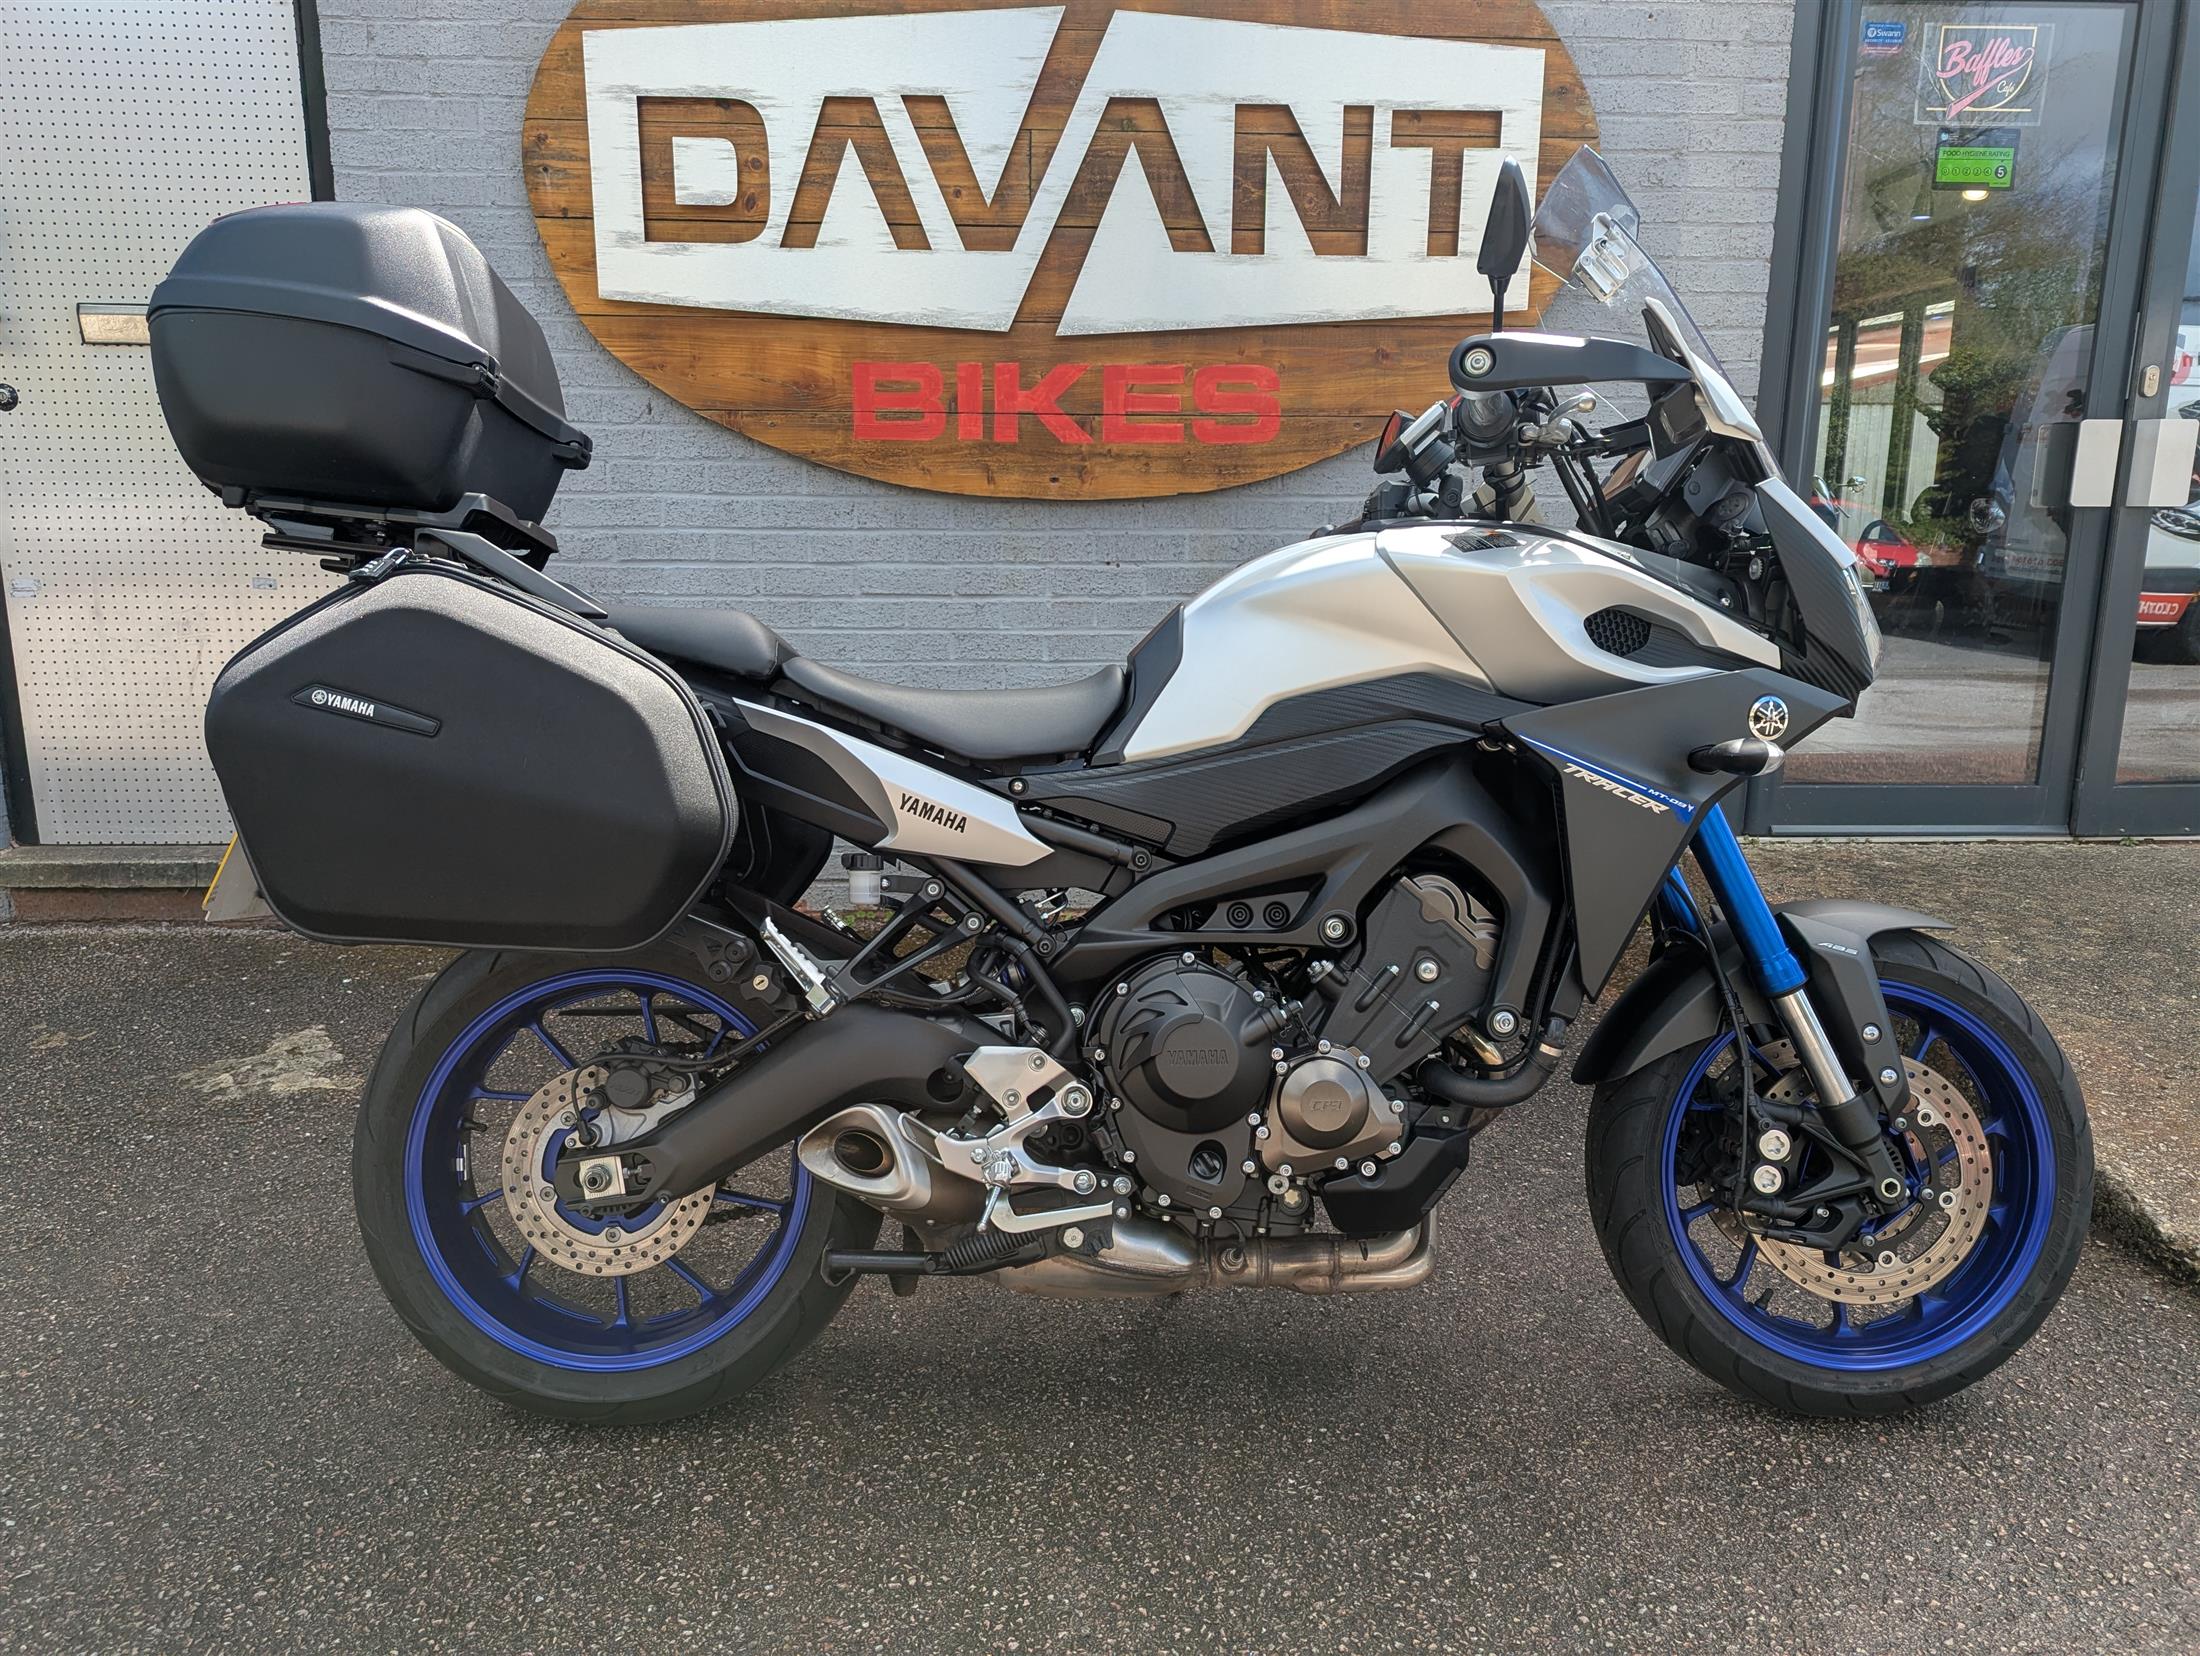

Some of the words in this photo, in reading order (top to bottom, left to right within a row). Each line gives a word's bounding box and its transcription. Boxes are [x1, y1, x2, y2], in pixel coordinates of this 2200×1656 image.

[1877, 28, 1901, 37] Swann
[1936, 38, 2034, 86] Baffles
[636, 94, 1503, 257] DAVANT
[851, 361, 1281, 445] BIKES
[327, 693, 374, 717] YAMAHA
[1562, 763, 1670, 814] TRACER
[1648, 789, 1687, 808] MT-09
[899, 793, 967, 833] YAMAHA
[1167, 1048, 1229, 1065] YAMAHA
